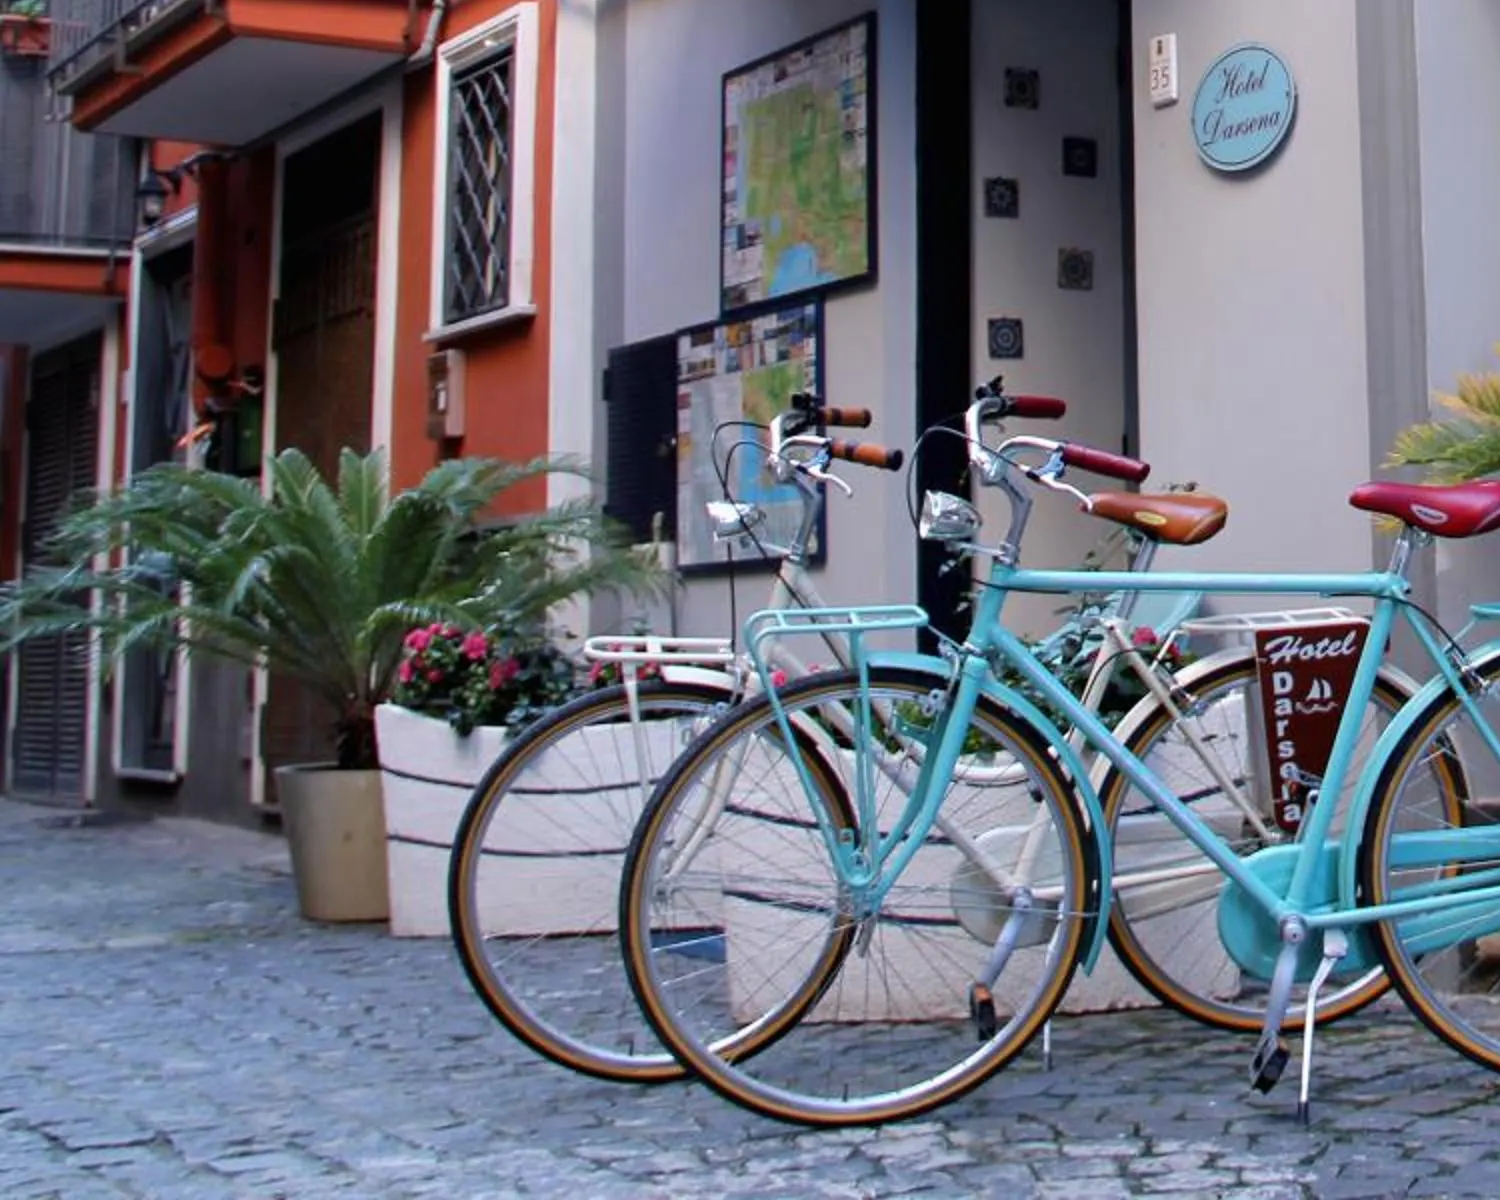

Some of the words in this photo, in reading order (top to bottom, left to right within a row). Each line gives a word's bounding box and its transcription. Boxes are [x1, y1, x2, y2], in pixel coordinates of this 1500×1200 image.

[1151, 65, 1170, 91] 35
[1215, 58, 1272, 104] Hotel
[1202, 109, 1281, 147] Darsena
[1264, 630, 1358, 665] Hotel
